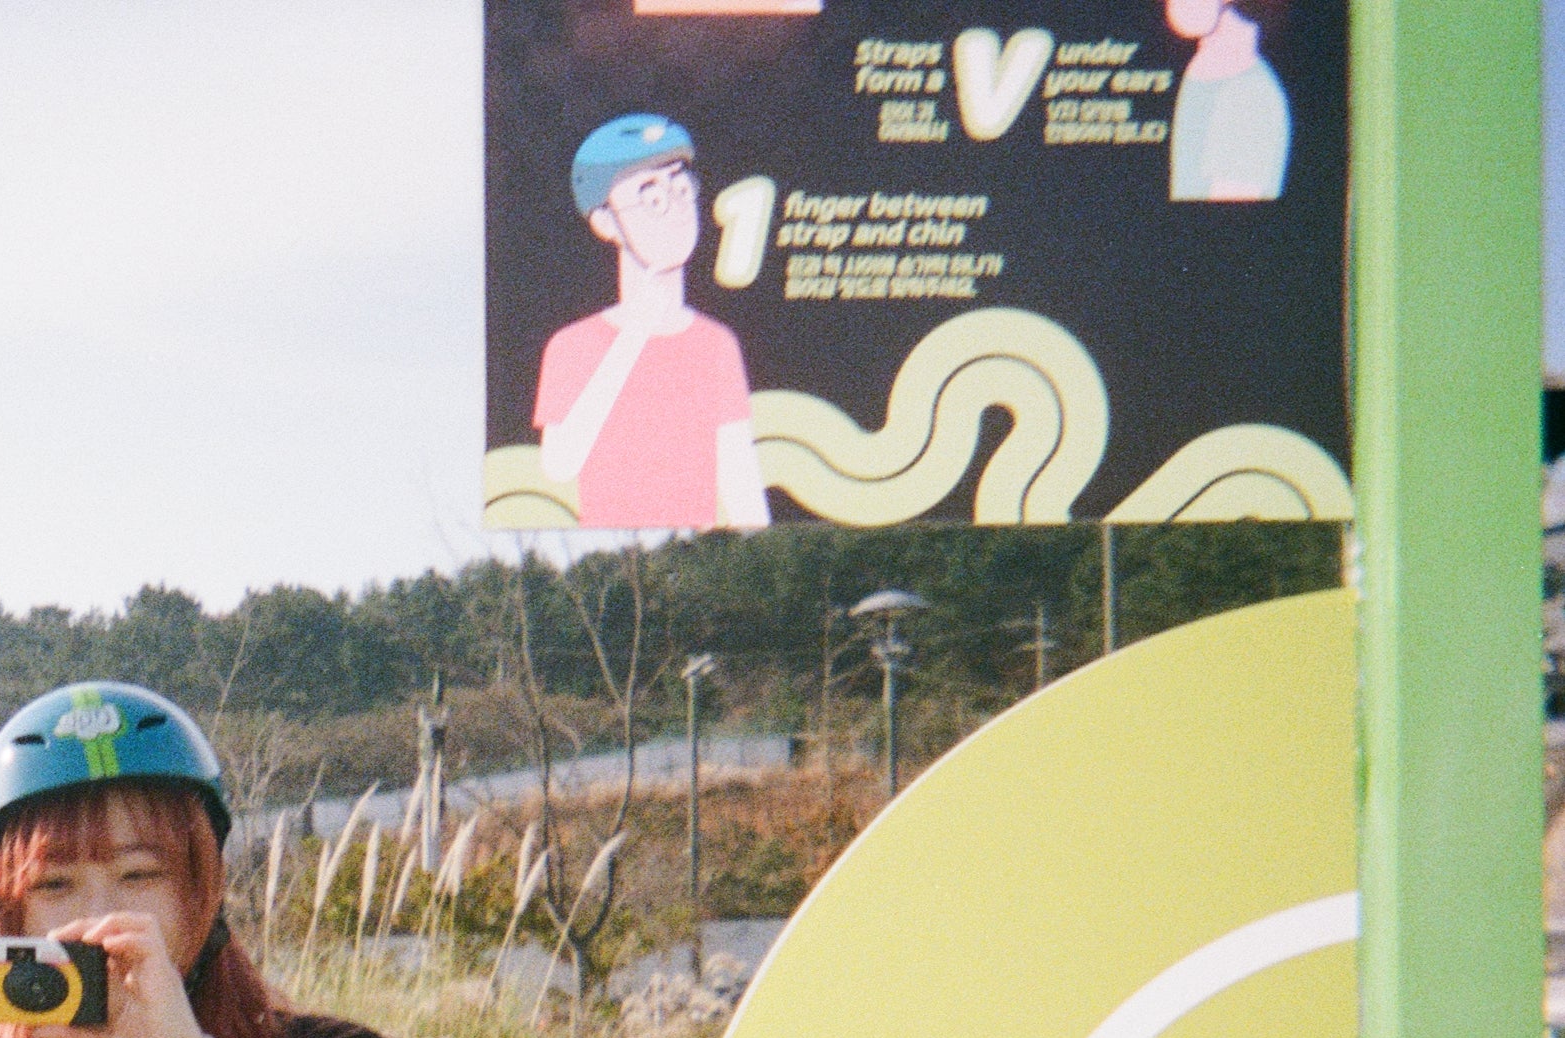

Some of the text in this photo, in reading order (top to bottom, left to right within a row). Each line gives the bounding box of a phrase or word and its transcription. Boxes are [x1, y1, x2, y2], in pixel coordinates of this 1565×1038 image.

[854, 39, 943, 68] Straps
[1056, 37, 1138, 66] under
[855, 65, 946, 94] form a
[952, 27, 1055, 142] V
[1042, 70, 1173, 99] your ears
[785, 190, 990, 223] finger between
[713, 175, 776, 289] 1
[777, 218, 966, 250] strap and chin
